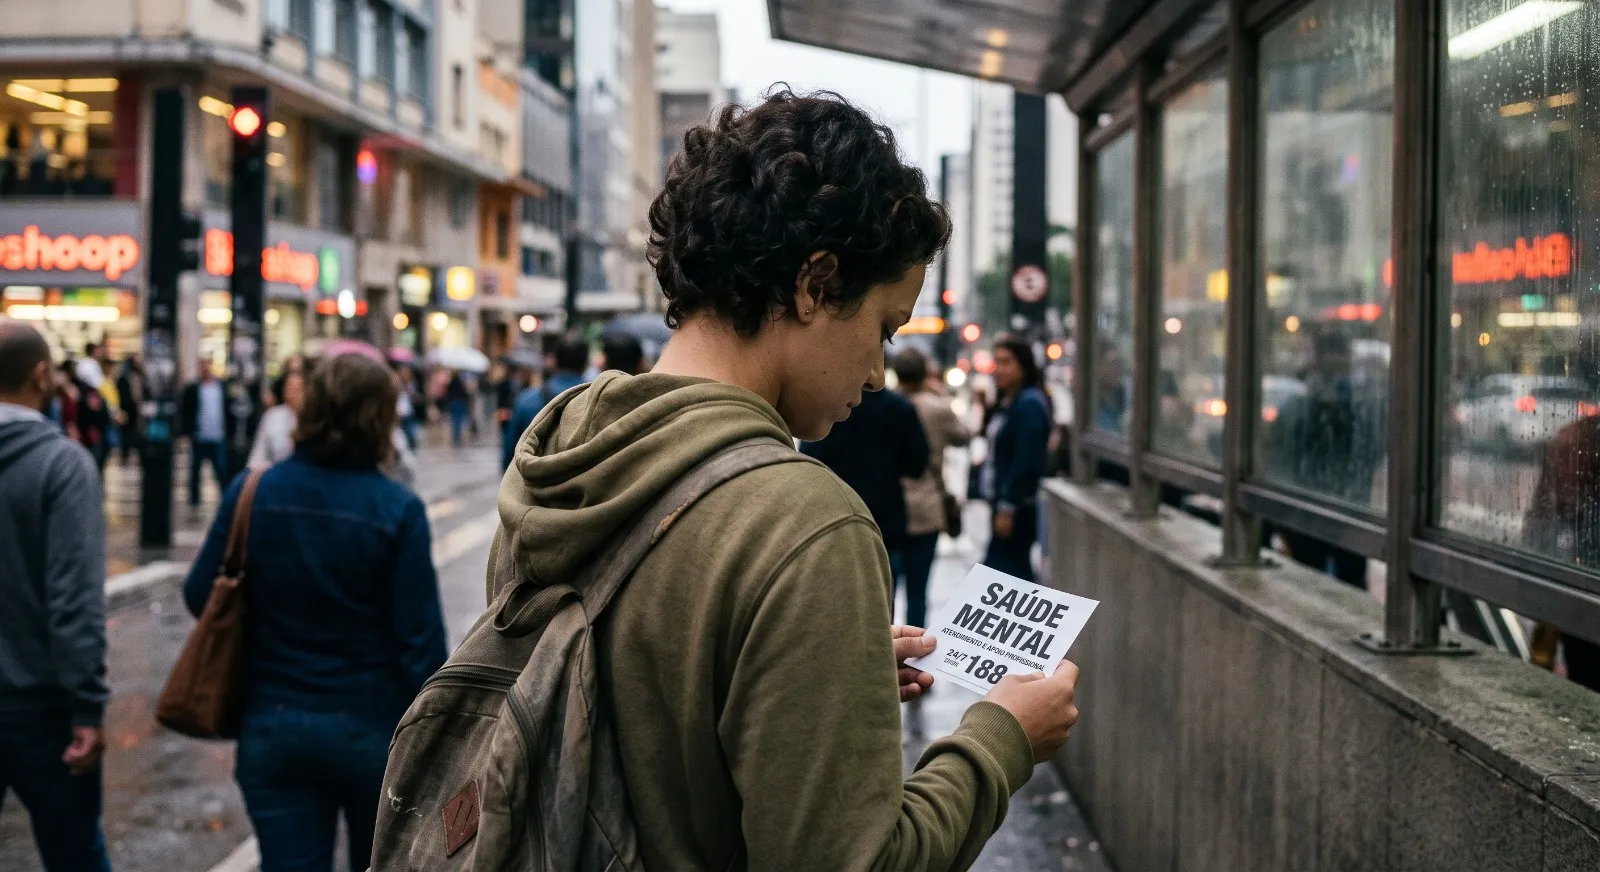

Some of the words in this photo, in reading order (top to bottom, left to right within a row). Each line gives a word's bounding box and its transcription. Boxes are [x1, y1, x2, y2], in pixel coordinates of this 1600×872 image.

[0, 225, 139, 281] shoop
[981, 582, 1069, 629] SAÚDE
[941, 627, 982, 648] ATENDIMENTO
[986, 645, 1006, 656] APOIO
[1004, 652, 1045, 671] PROFISSIONAL
[952, 603, 1056, 660] MENTAL
[946, 648, 968, 662] 24/7
[964, 655, 1008, 685] 188
